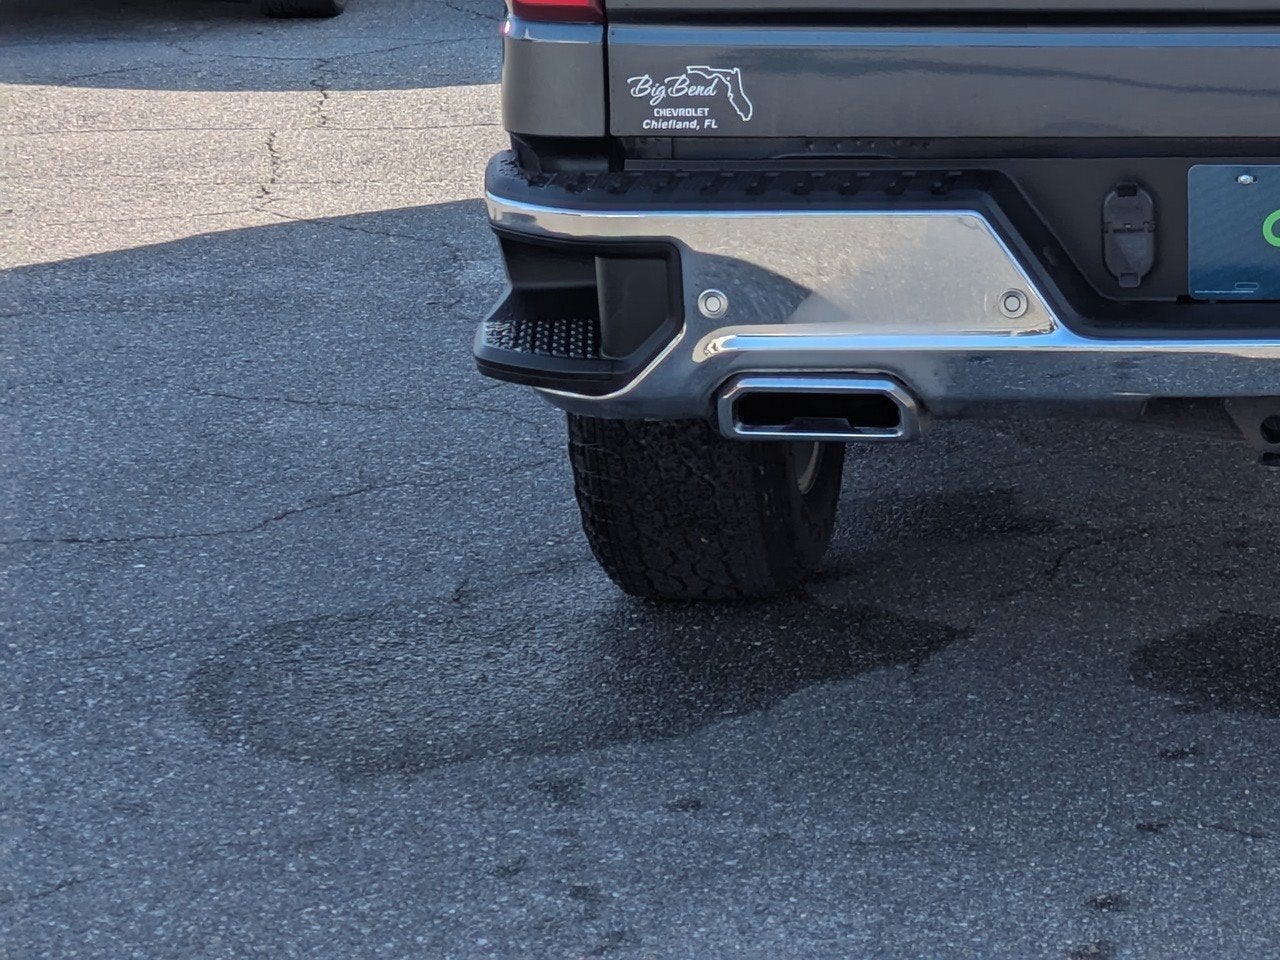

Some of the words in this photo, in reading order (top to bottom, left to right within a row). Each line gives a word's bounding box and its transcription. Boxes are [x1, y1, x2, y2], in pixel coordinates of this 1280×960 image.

[627, 74, 666, 105] Big
[664, 74, 719, 97] Bend
[653, 107, 710, 117] CHEVROLET
[642, 119, 700, 131] Chiefland,
[703, 119, 719, 129] FL
